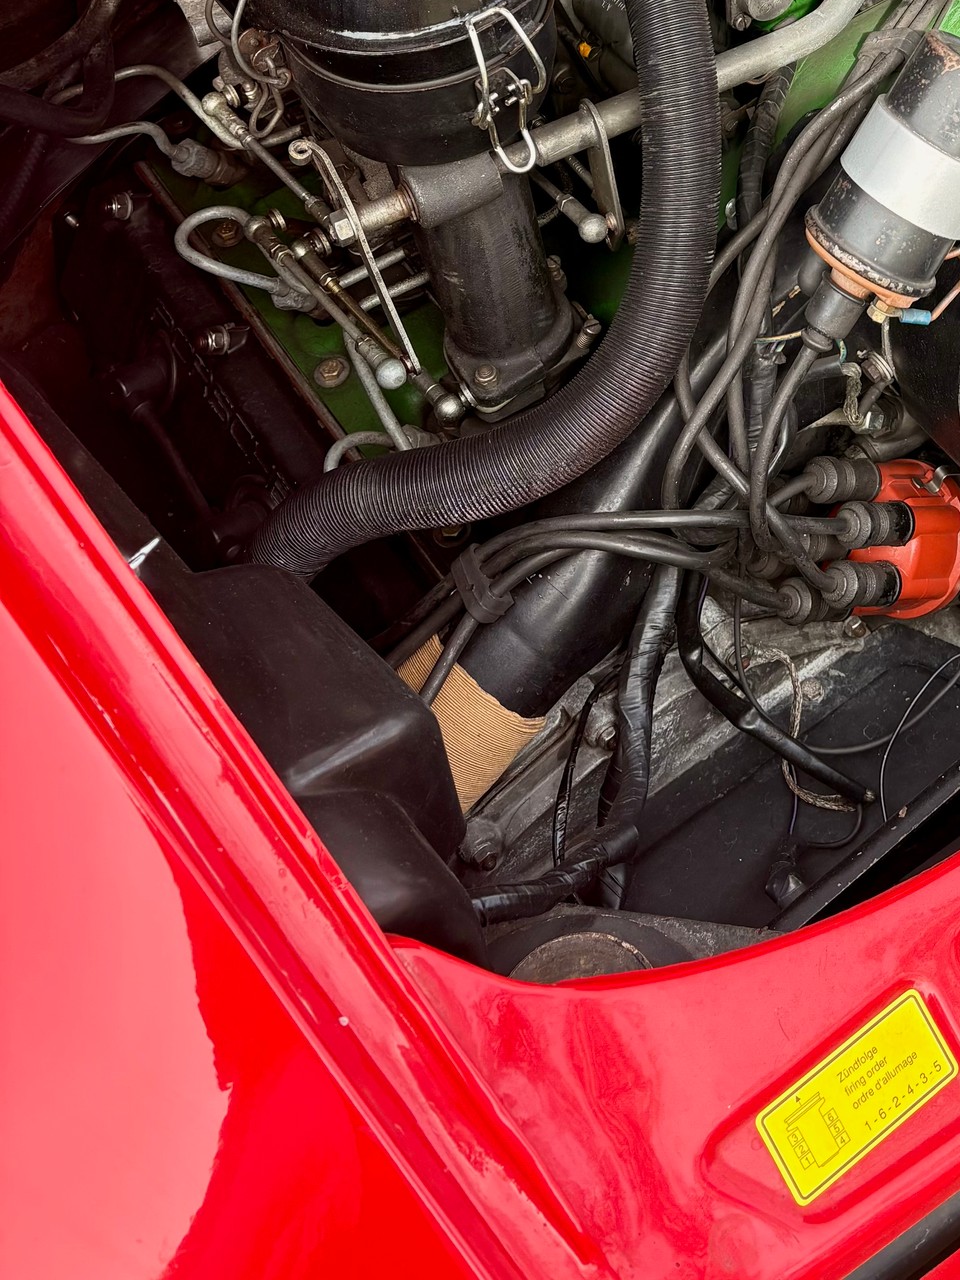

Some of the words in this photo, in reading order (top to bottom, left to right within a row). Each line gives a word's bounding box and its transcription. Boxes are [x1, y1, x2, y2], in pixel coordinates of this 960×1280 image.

[836, 1046, 878, 1084] Zündfolge
[844, 1075, 867, 1097] firing
[866, 1056, 888, 1079] order
[852, 1088, 875, 1110] ordre
[874, 1051, 918, 1091] d'allumage
[878, 1107, 887, 1120] 6
[892, 1095, 902, 1109] 2
[907, 1084, 914, 1095] 4
[919, 1072, 928, 1084] 3
[933, 1059, 942, 1073] 5
